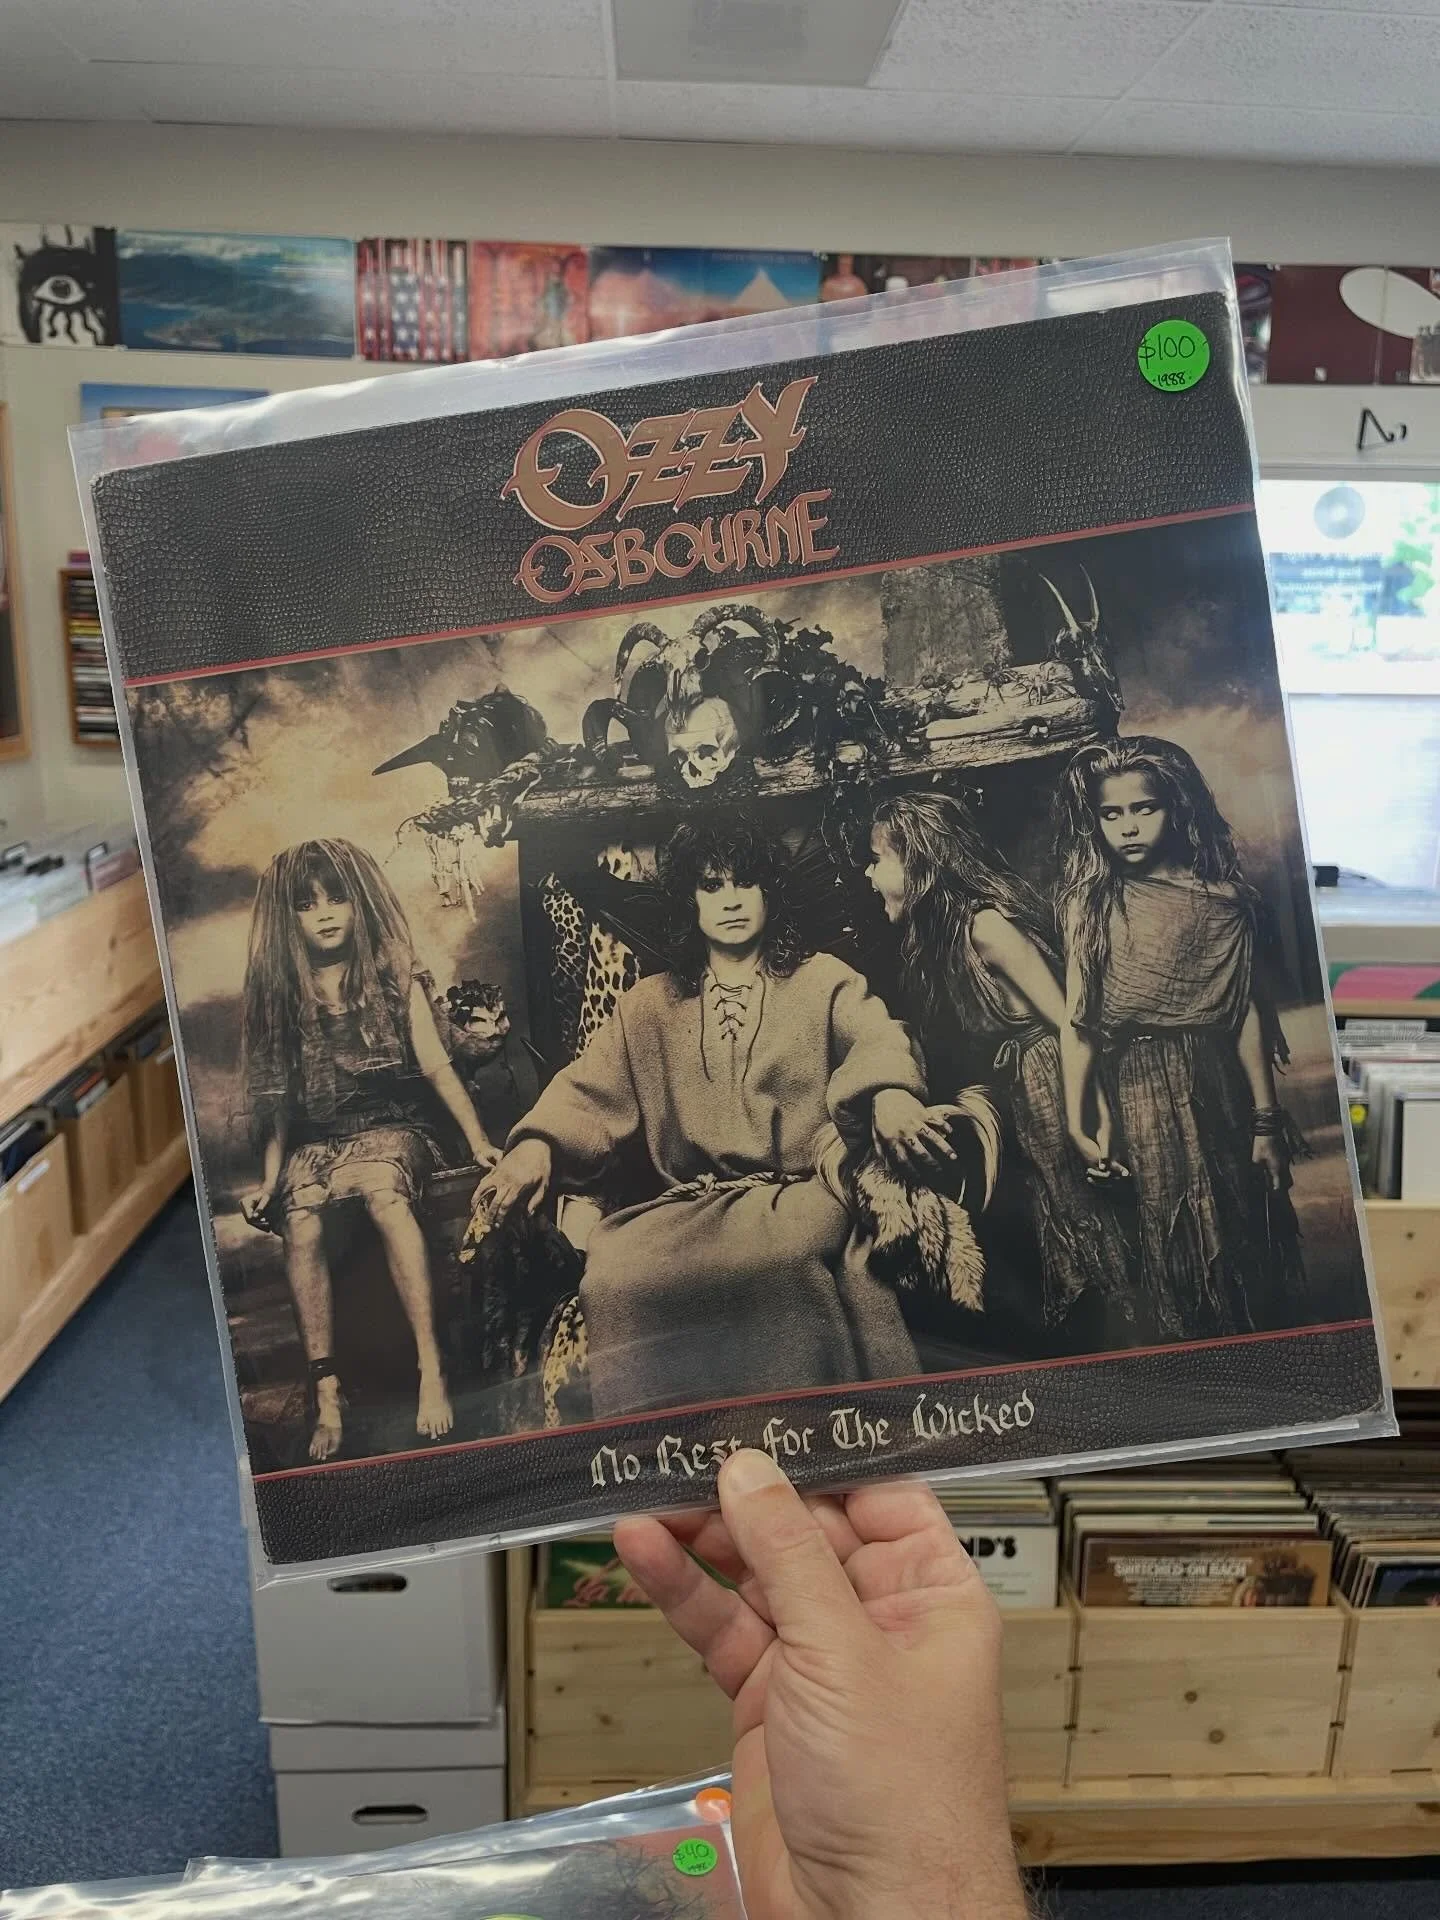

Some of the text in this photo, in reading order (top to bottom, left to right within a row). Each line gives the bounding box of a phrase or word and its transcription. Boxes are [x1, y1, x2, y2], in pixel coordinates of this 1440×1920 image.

[1137, 333, 1196, 370] $100
[1157, 371, 1186, 388] 1988
[501, 375, 819, 531] OZZY
[512, 488, 841, 603] OSBOURNE
[590, 1444, 641, 1488] No
[829, 1407, 893, 1456] The
[911, 1388, 1036, 1440] Wicked
